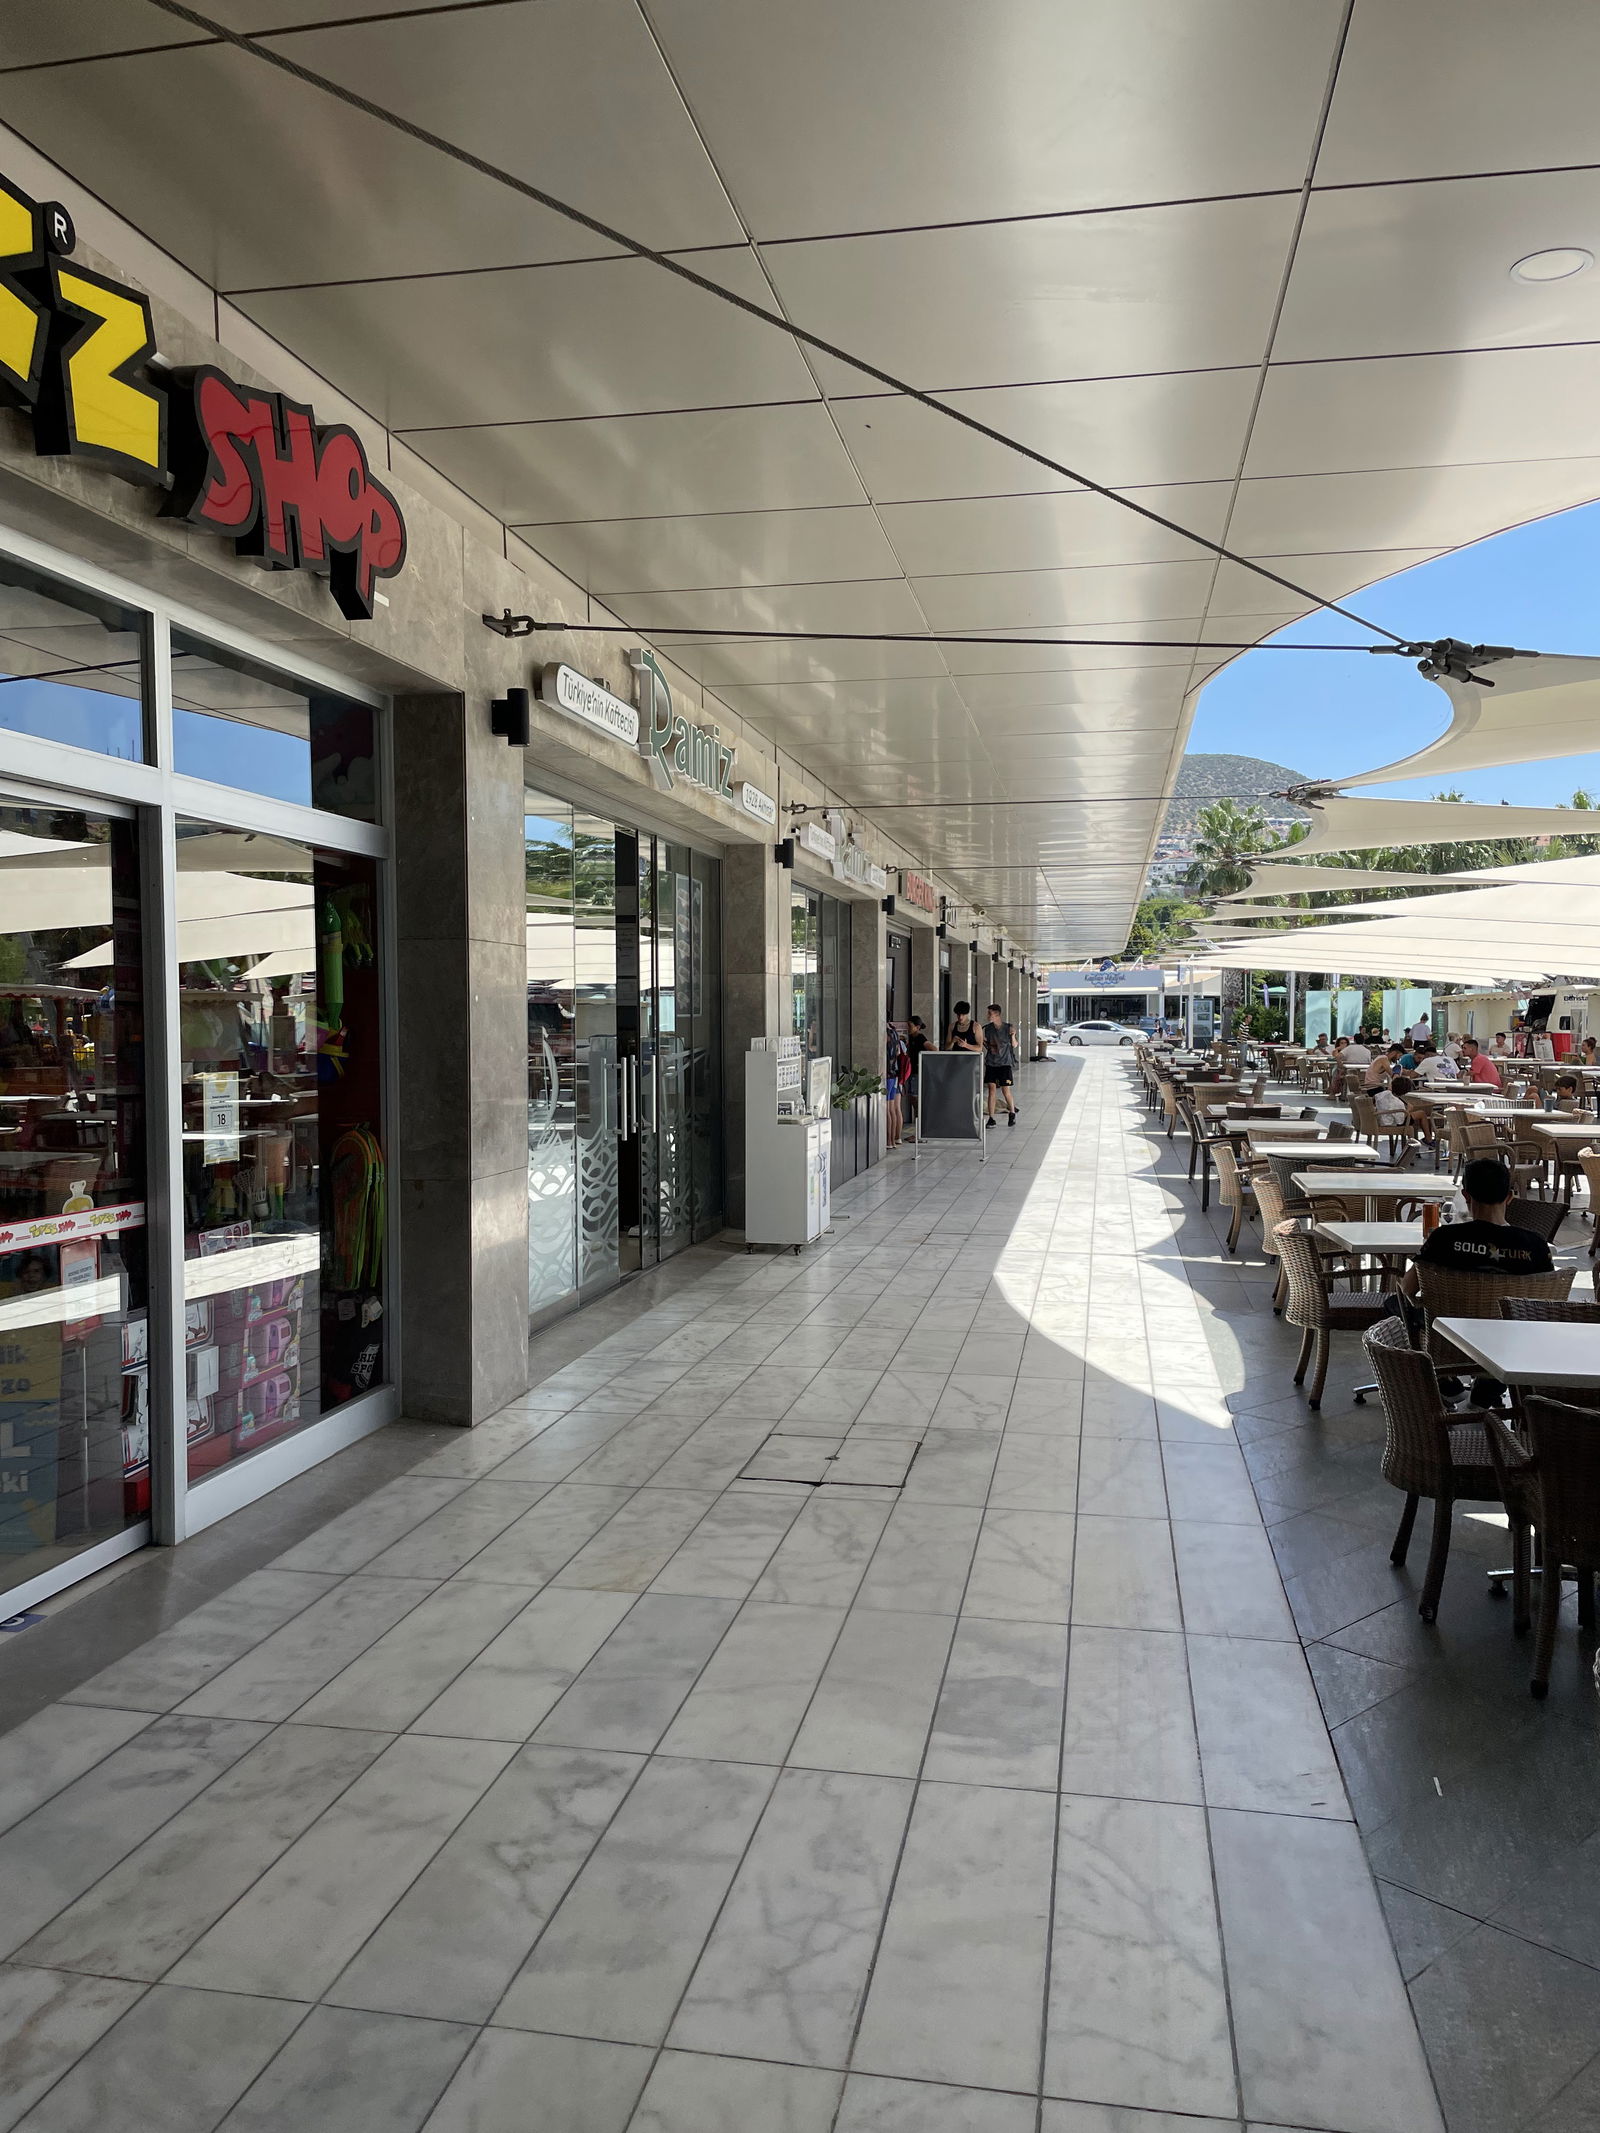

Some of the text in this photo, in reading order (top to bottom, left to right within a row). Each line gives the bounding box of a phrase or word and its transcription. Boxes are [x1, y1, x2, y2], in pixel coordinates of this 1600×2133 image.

[197, 372, 405, 602] SHOP
[563, 672, 635, 737] Türkiye'nin Köftecisi
[638, 648, 735, 800] Ramiz
[745, 788, 759, 808] 1928
[217, 1113, 226, 1126] 18
[1453, 1241, 1487, 1255] SOLO
